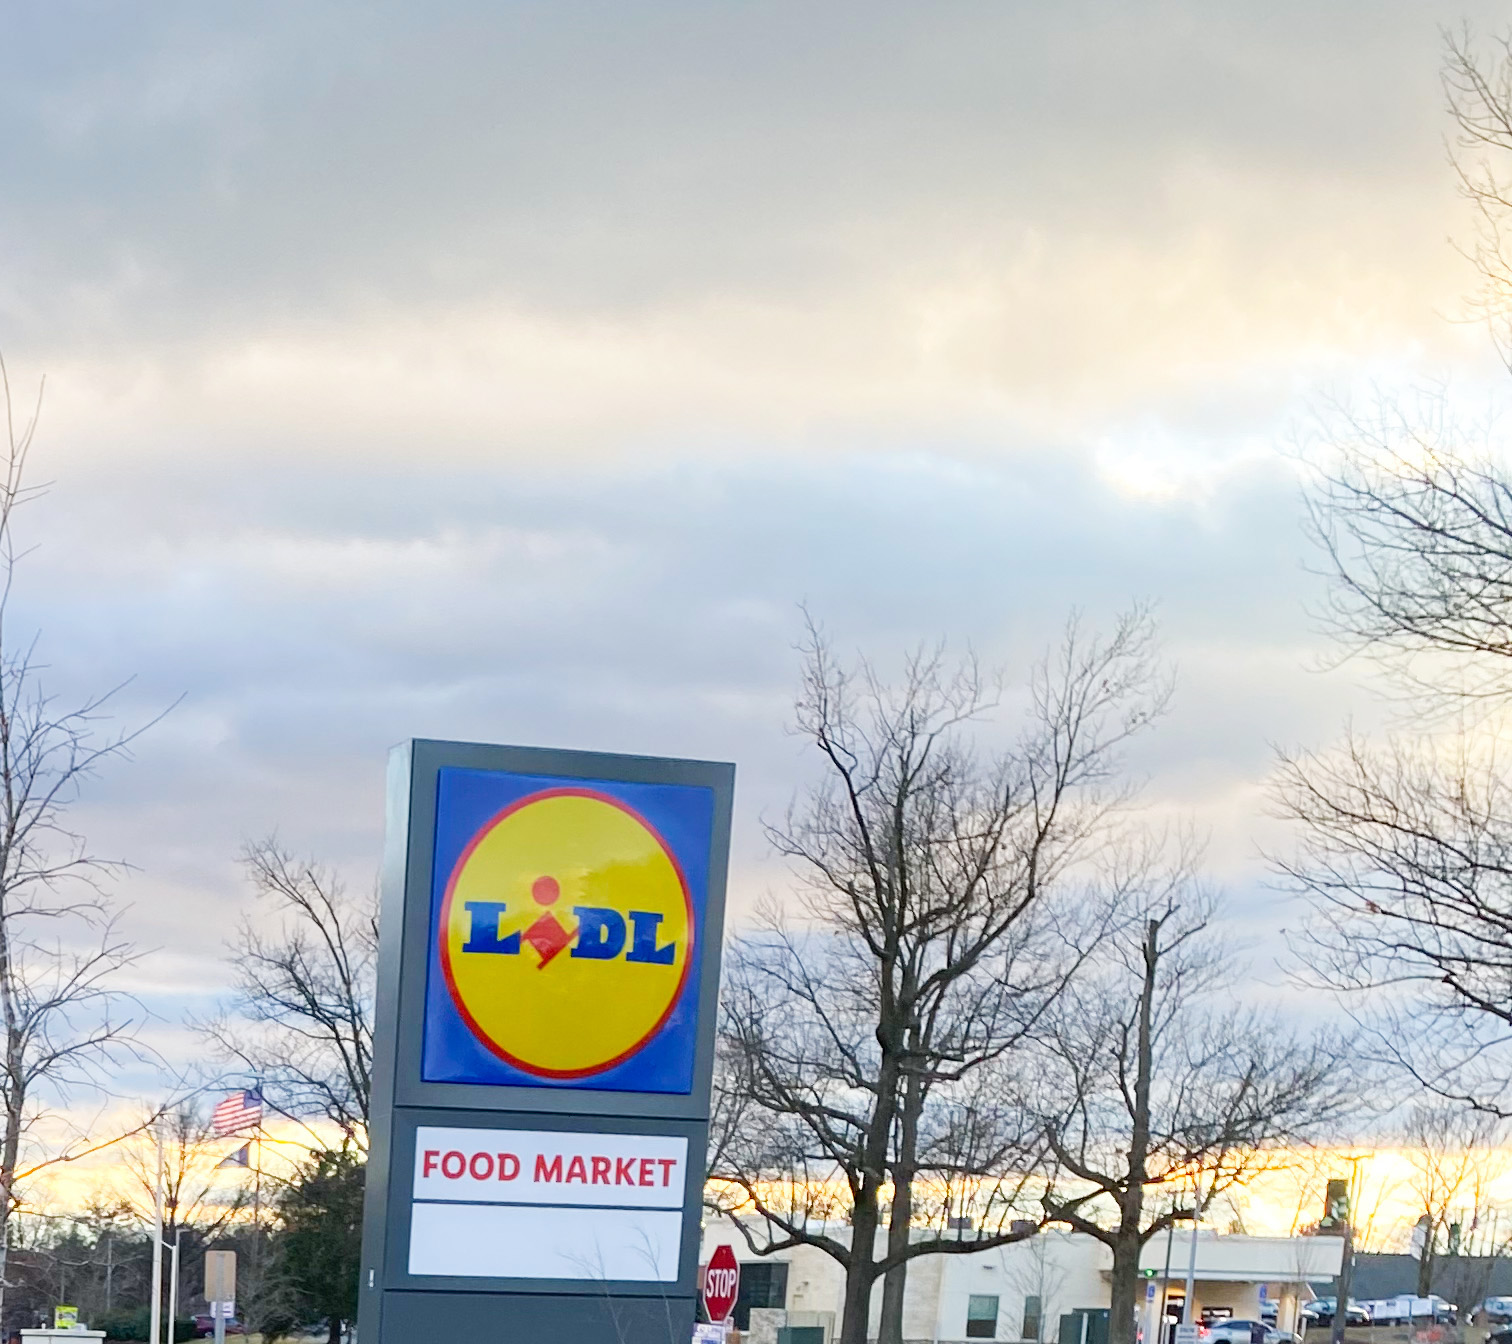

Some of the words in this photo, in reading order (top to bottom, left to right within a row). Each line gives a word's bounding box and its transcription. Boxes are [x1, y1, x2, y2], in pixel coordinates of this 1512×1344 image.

[423, 1150, 520, 1181] FOOD
[533, 1154, 677, 1187] MARKET
[706, 1268, 736, 1298] STOP
